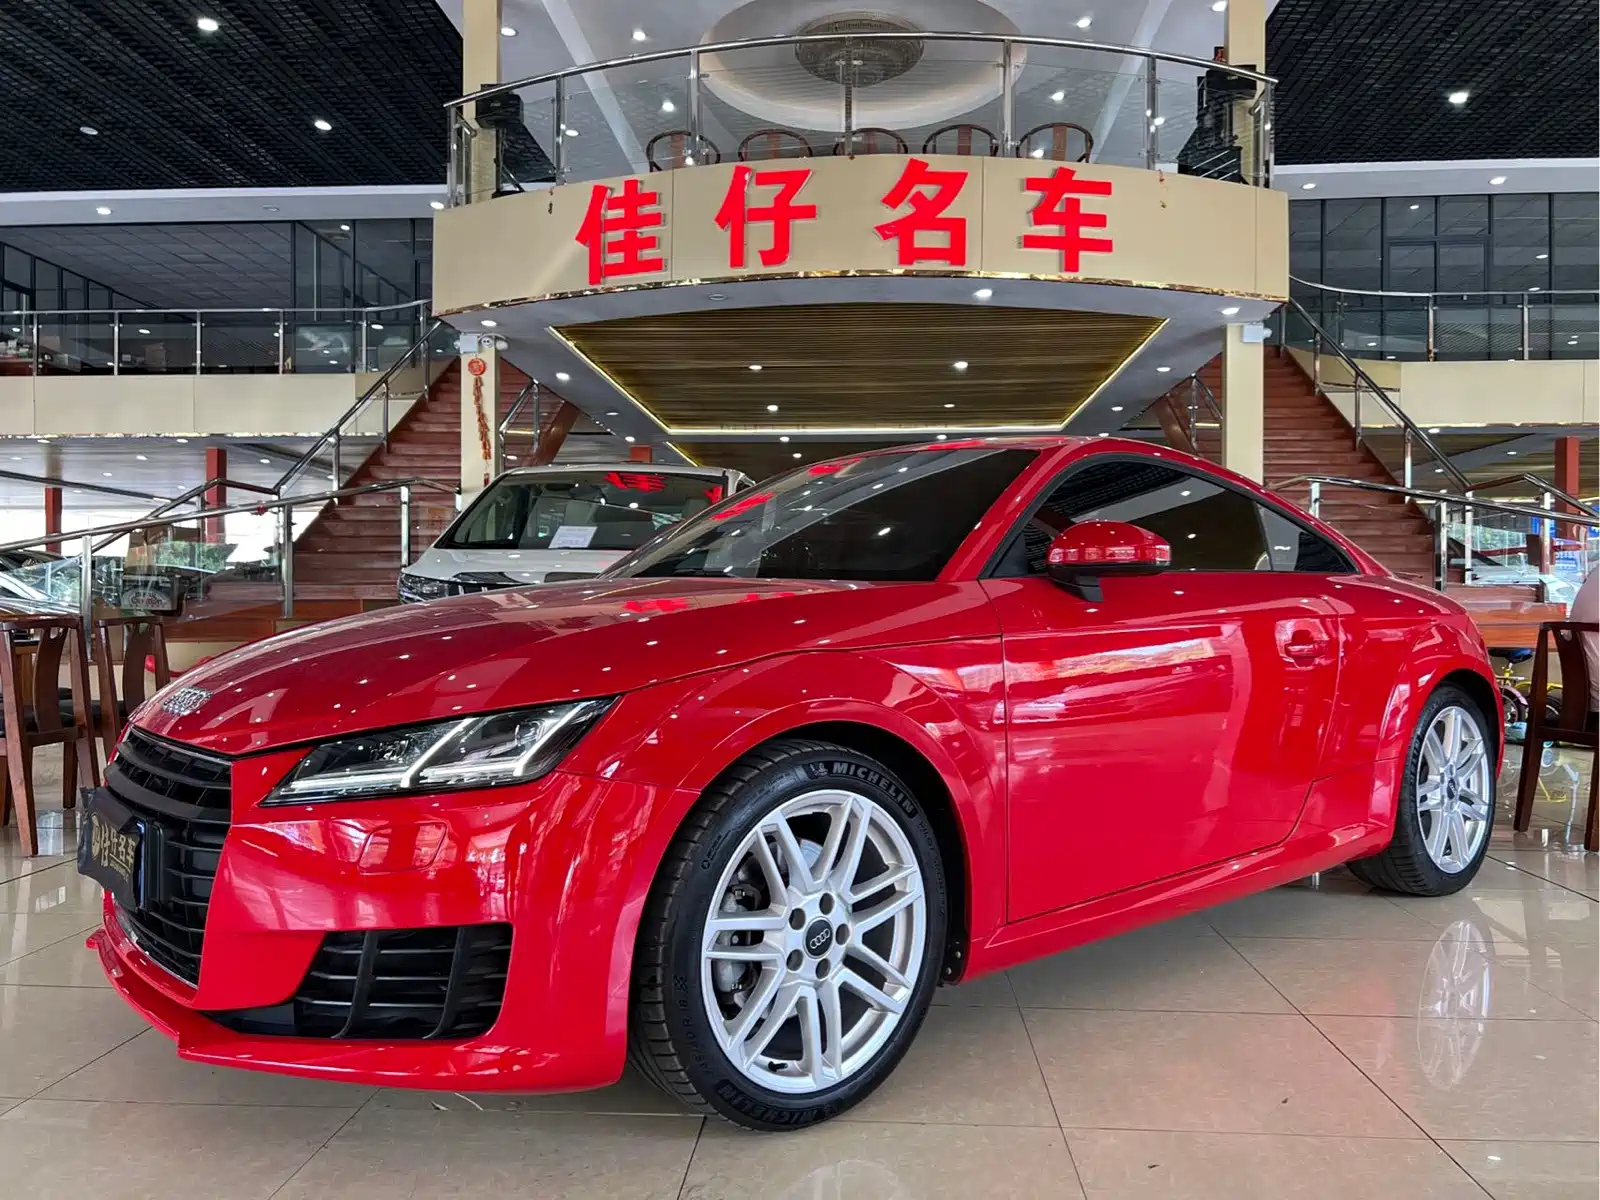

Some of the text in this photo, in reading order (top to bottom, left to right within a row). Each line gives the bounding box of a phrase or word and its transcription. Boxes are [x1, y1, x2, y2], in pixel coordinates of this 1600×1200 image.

[576, 158, 1114, 285] 佳仔名车
[832, 761, 916, 815] MICHELIN
